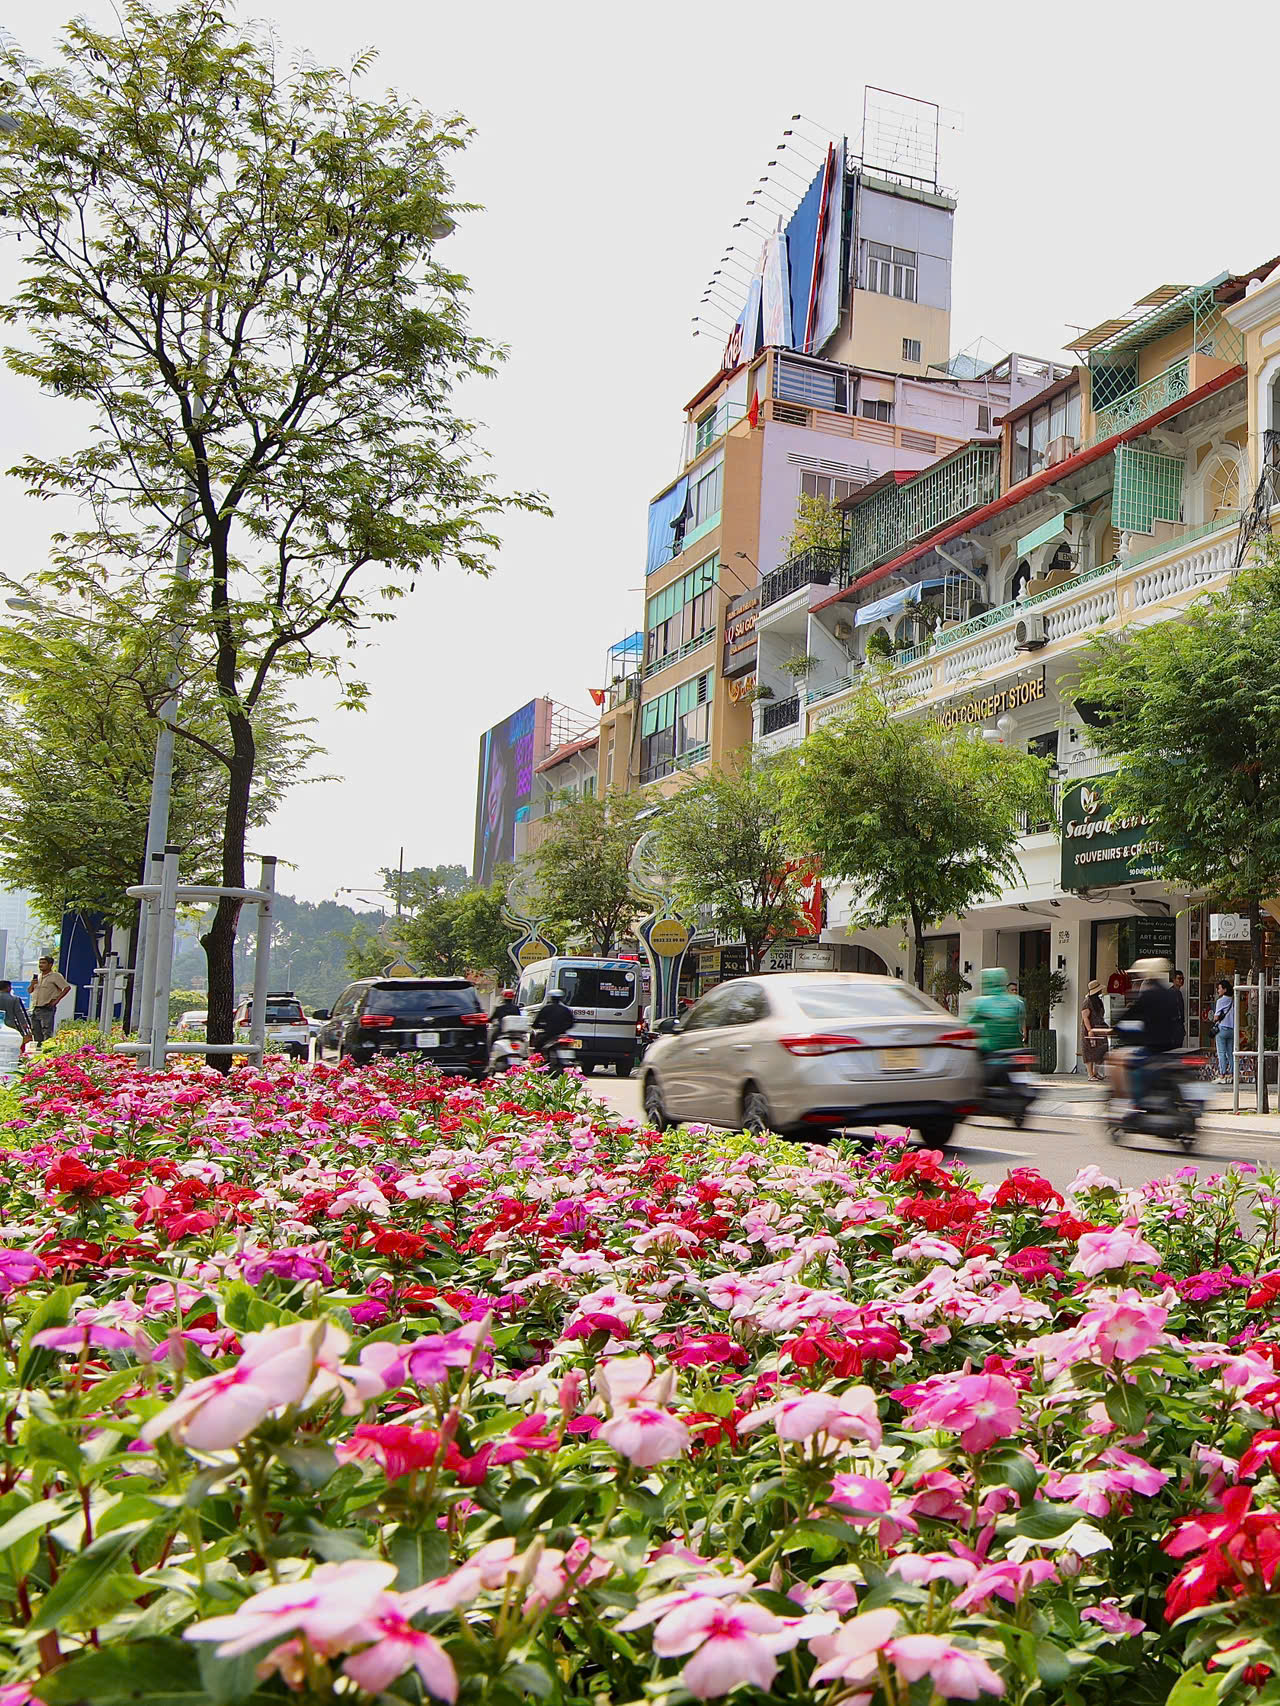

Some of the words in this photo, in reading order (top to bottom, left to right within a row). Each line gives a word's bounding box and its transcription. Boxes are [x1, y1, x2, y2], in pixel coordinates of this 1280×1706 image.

[960, 690, 1007, 723] CONCEPT
[1008, 676, 1045, 709] STORE
[1065, 816, 1112, 839] Saigon
[1074, 847, 1121, 865] SOUVENIRS
[1122, 846, 1129, 857] &
[724, 961, 739, 970] XQ
[770, 959, 792, 970] 24H
